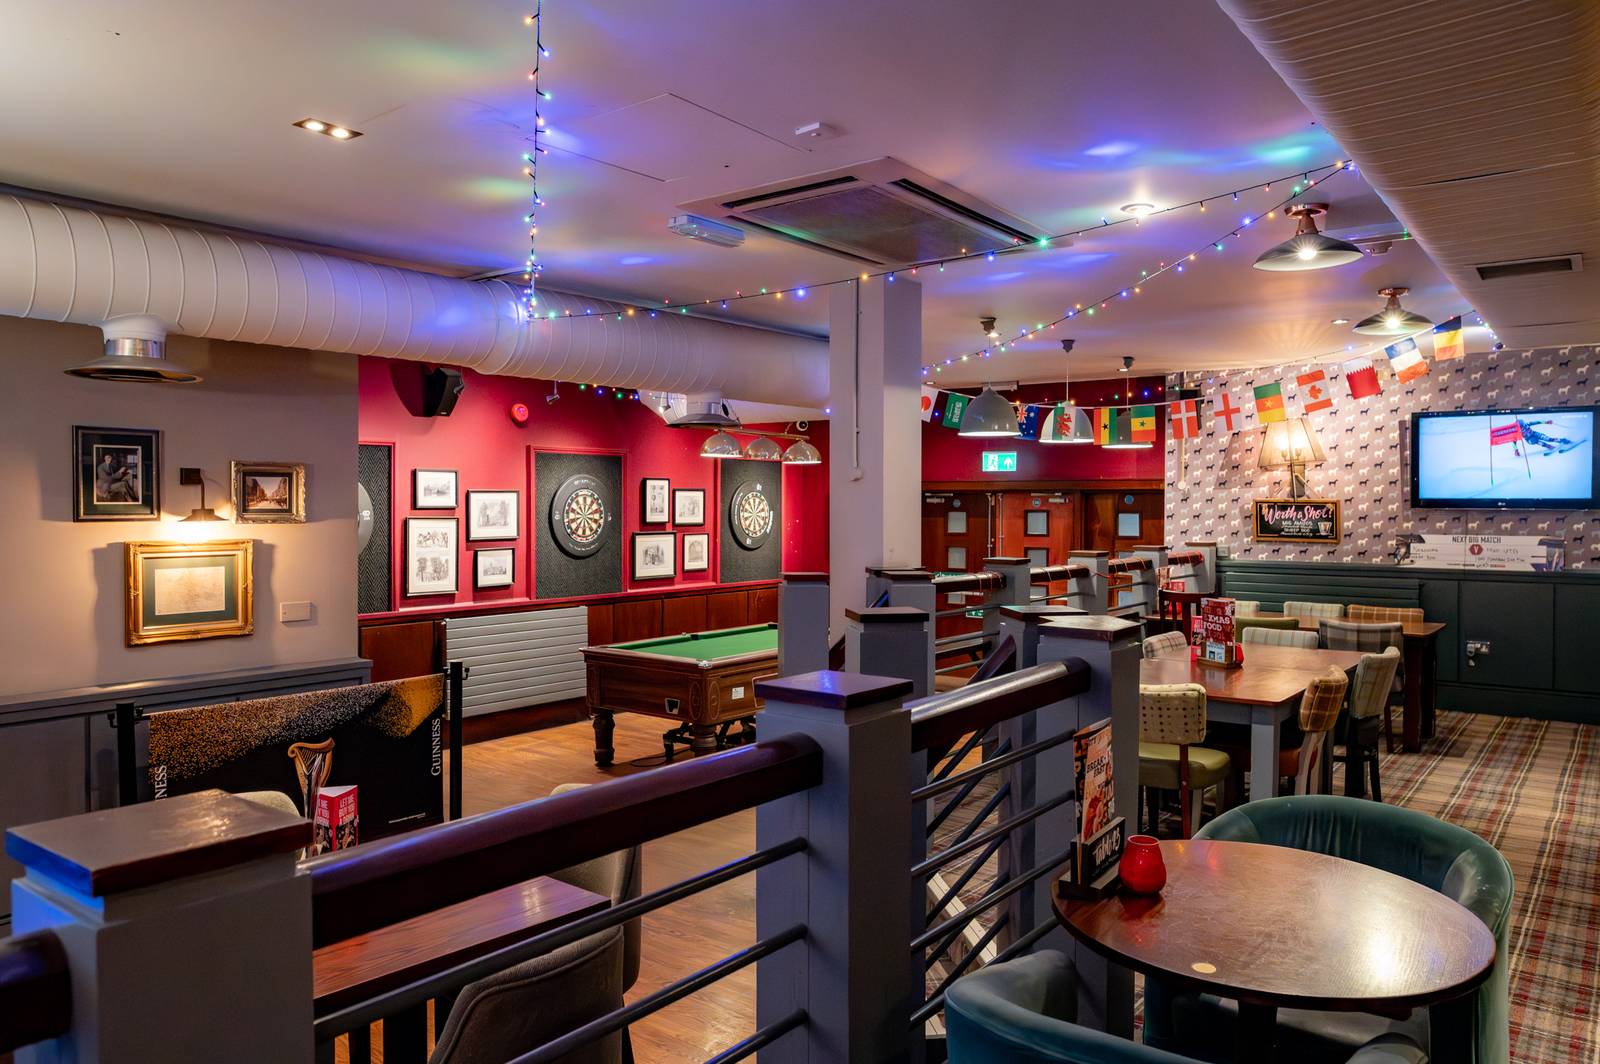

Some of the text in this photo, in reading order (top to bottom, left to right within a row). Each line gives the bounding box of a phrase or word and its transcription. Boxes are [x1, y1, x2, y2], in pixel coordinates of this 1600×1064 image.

[1263, 504, 1297, 525] Worth
[1480, 536, 1502, 544] MATCH
[1208, 614, 1230, 625] XMAS
[431, 718, 441, 776] GUINNESS
[1094, 763, 1105, 778] FAST
